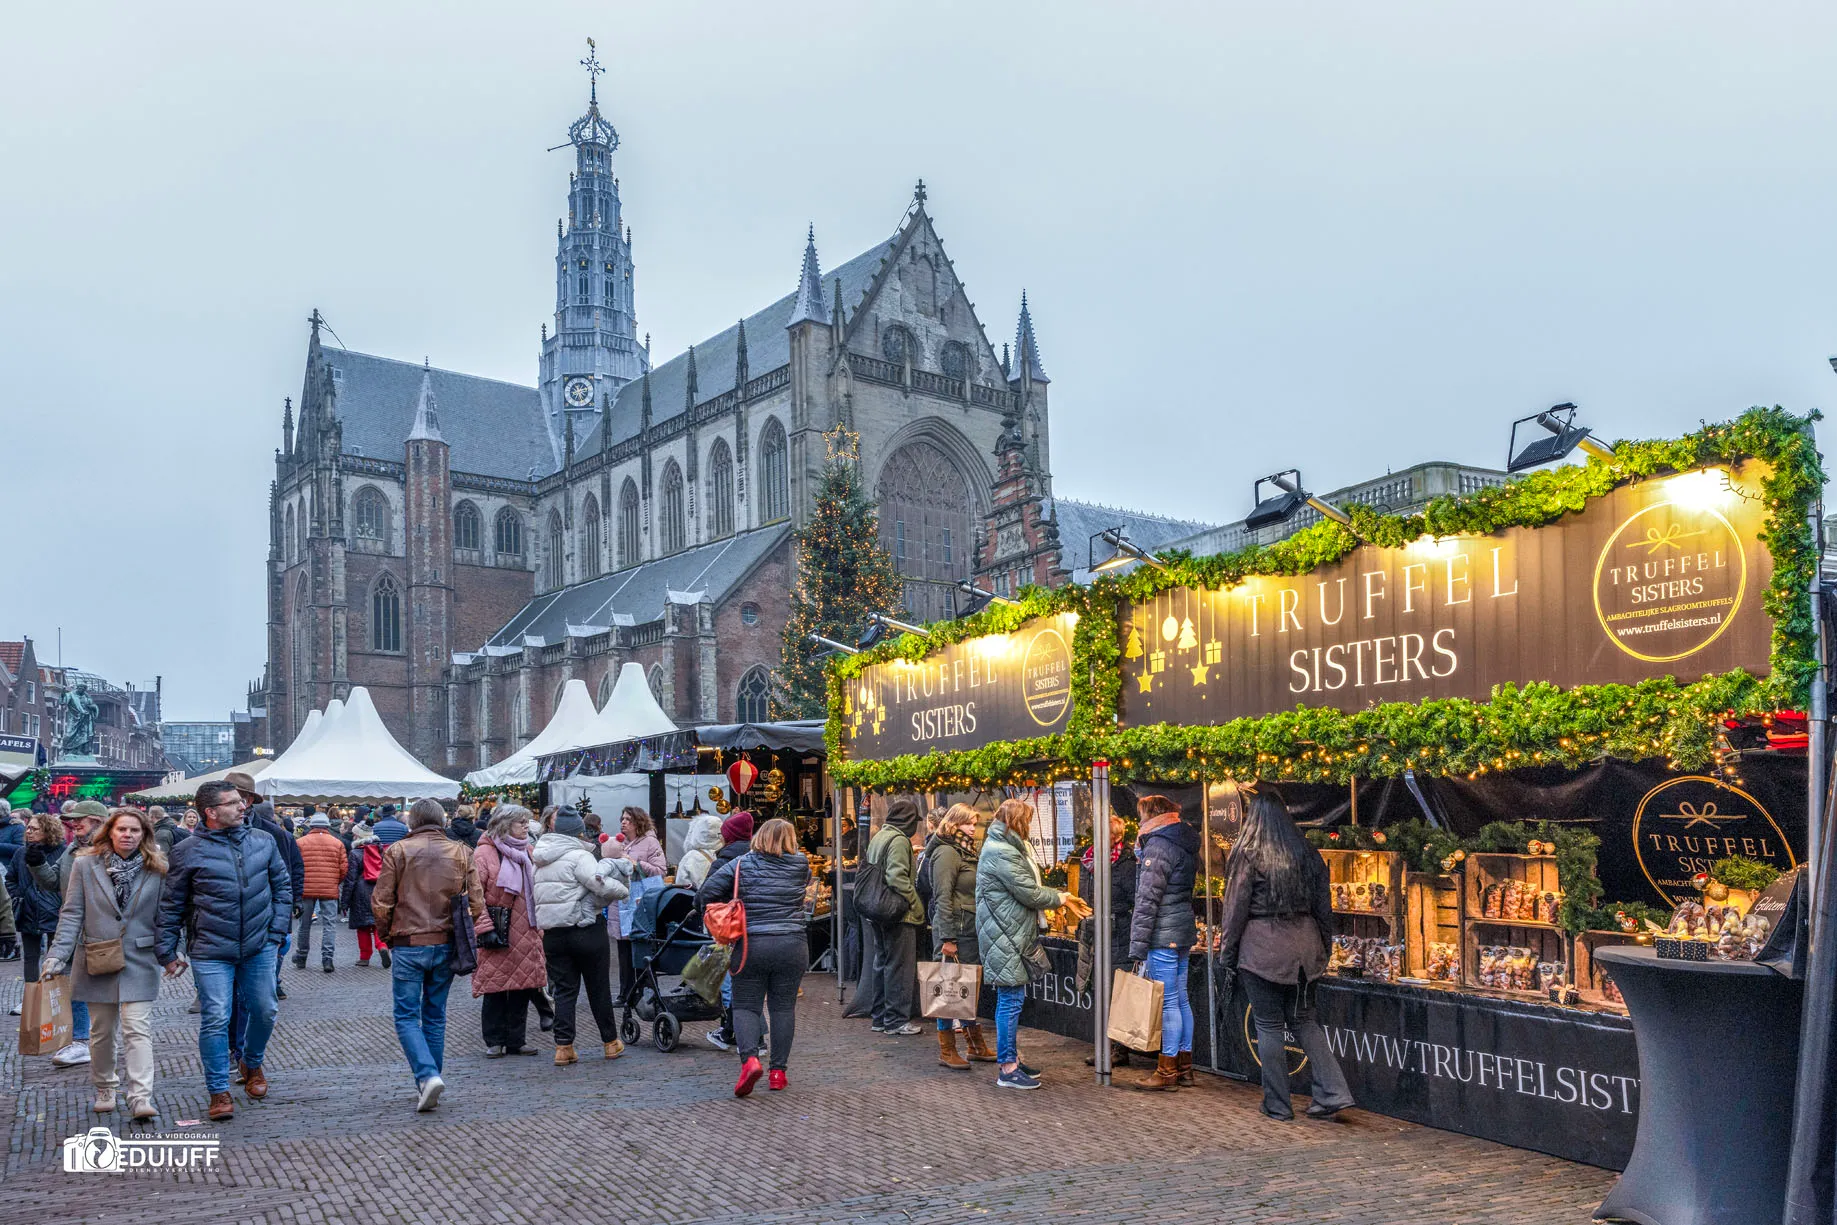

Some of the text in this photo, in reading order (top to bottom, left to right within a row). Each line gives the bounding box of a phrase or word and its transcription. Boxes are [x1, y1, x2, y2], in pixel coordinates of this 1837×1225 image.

[1610, 550, 1726, 586] TRUFFEL
[1245, 546, 1519, 637] TRUFFEL
[1631, 577, 1704, 604] SISTERS
[1606, 597, 1734, 622] AMBACHTELIJKE SLAGROOMTRUFFELS
[1617, 613, 1722, 637] www.truffelsisters.nl
[1027, 660, 1066, 679] TRUFFEL
[1288, 628, 1457, 694] SISTERS
[895, 656, 998, 704] TRUFFEL
[1035, 675, 1060, 691] SISTERS
[911, 701, 977, 742] SISTERS
[0, 739, 32, 749] AFELS
[1650, 833, 1775, 857] TRUFFEL
[1678, 856, 1716, 874] SIST
[1657, 879, 1693, 887] AMBACHT
[1323, 1025, 1640, 1114] WWW.TRUFFELSIST
